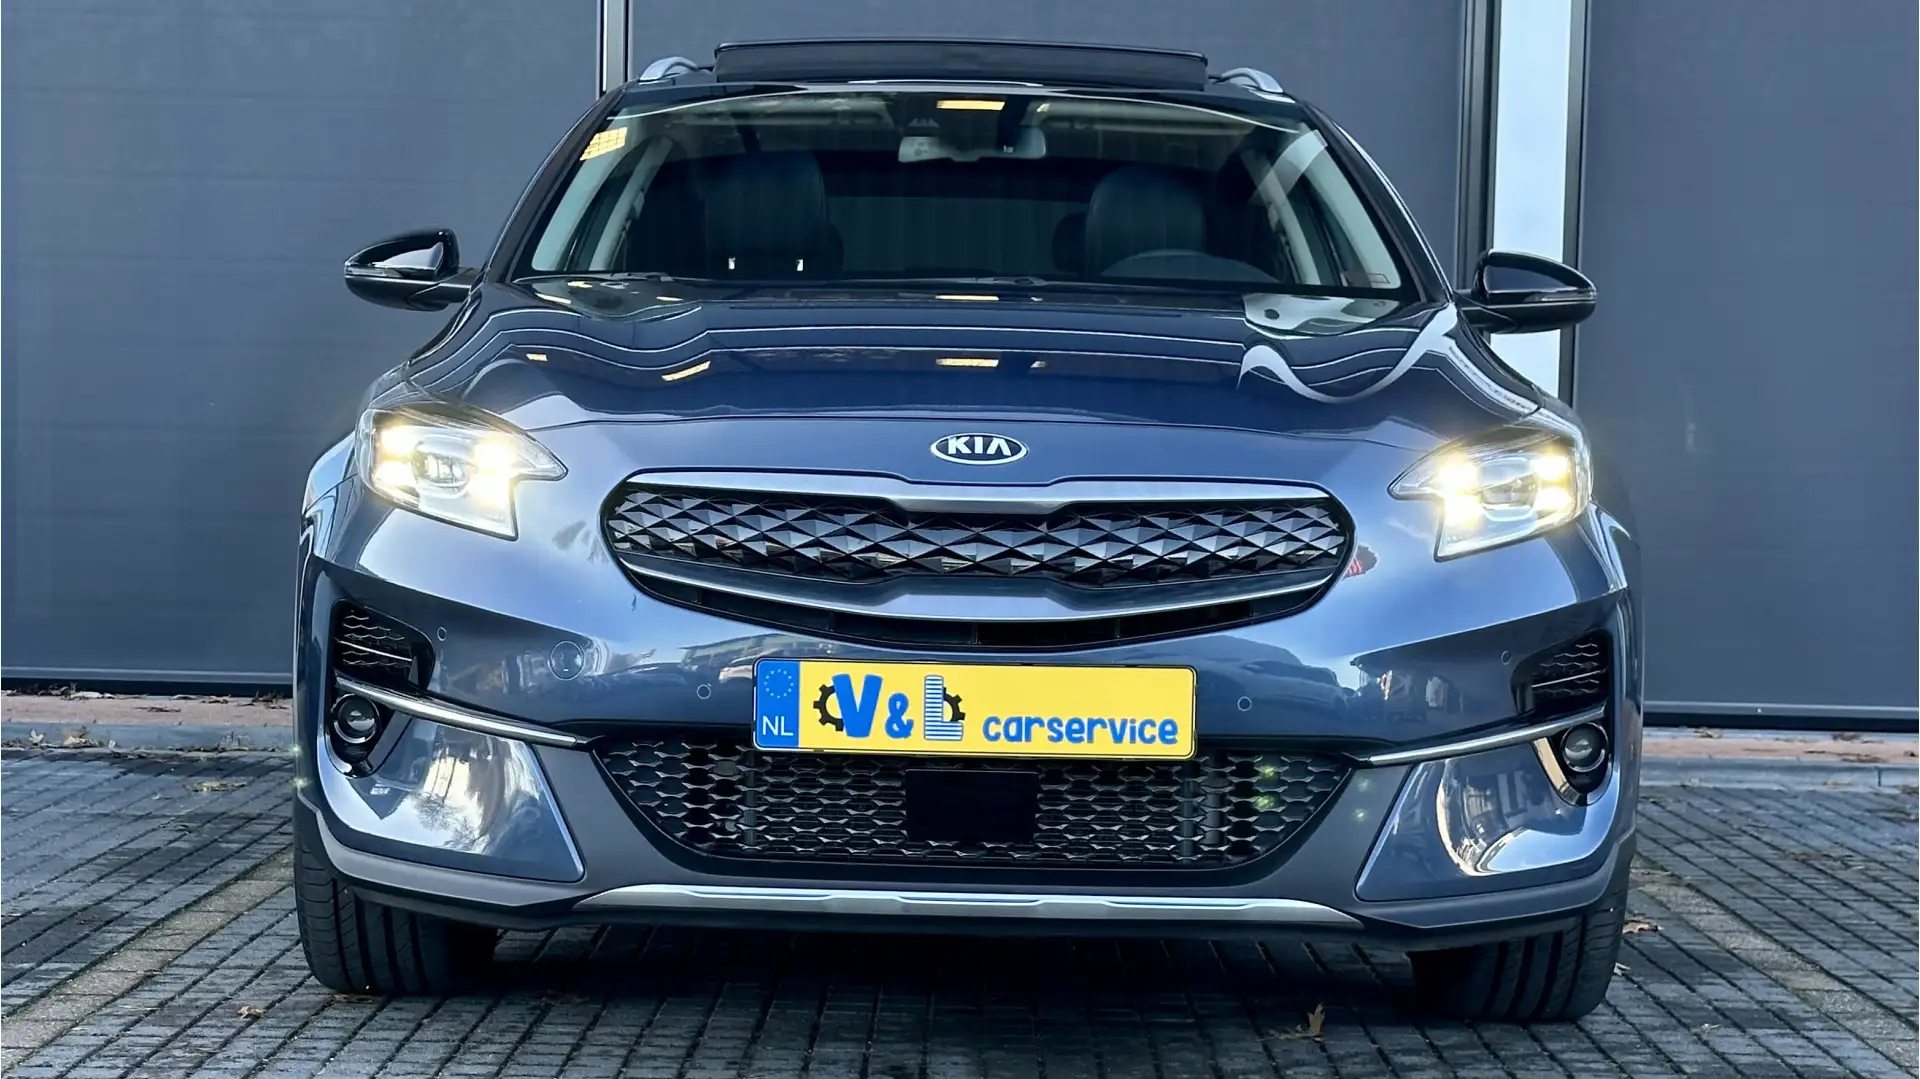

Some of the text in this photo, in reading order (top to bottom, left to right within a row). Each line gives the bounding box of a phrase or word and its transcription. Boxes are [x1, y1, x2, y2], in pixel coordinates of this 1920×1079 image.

[947, 436, 1012, 456] KIA
[762, 715, 794, 737] NL
[982, 714, 1179, 745] carservice
